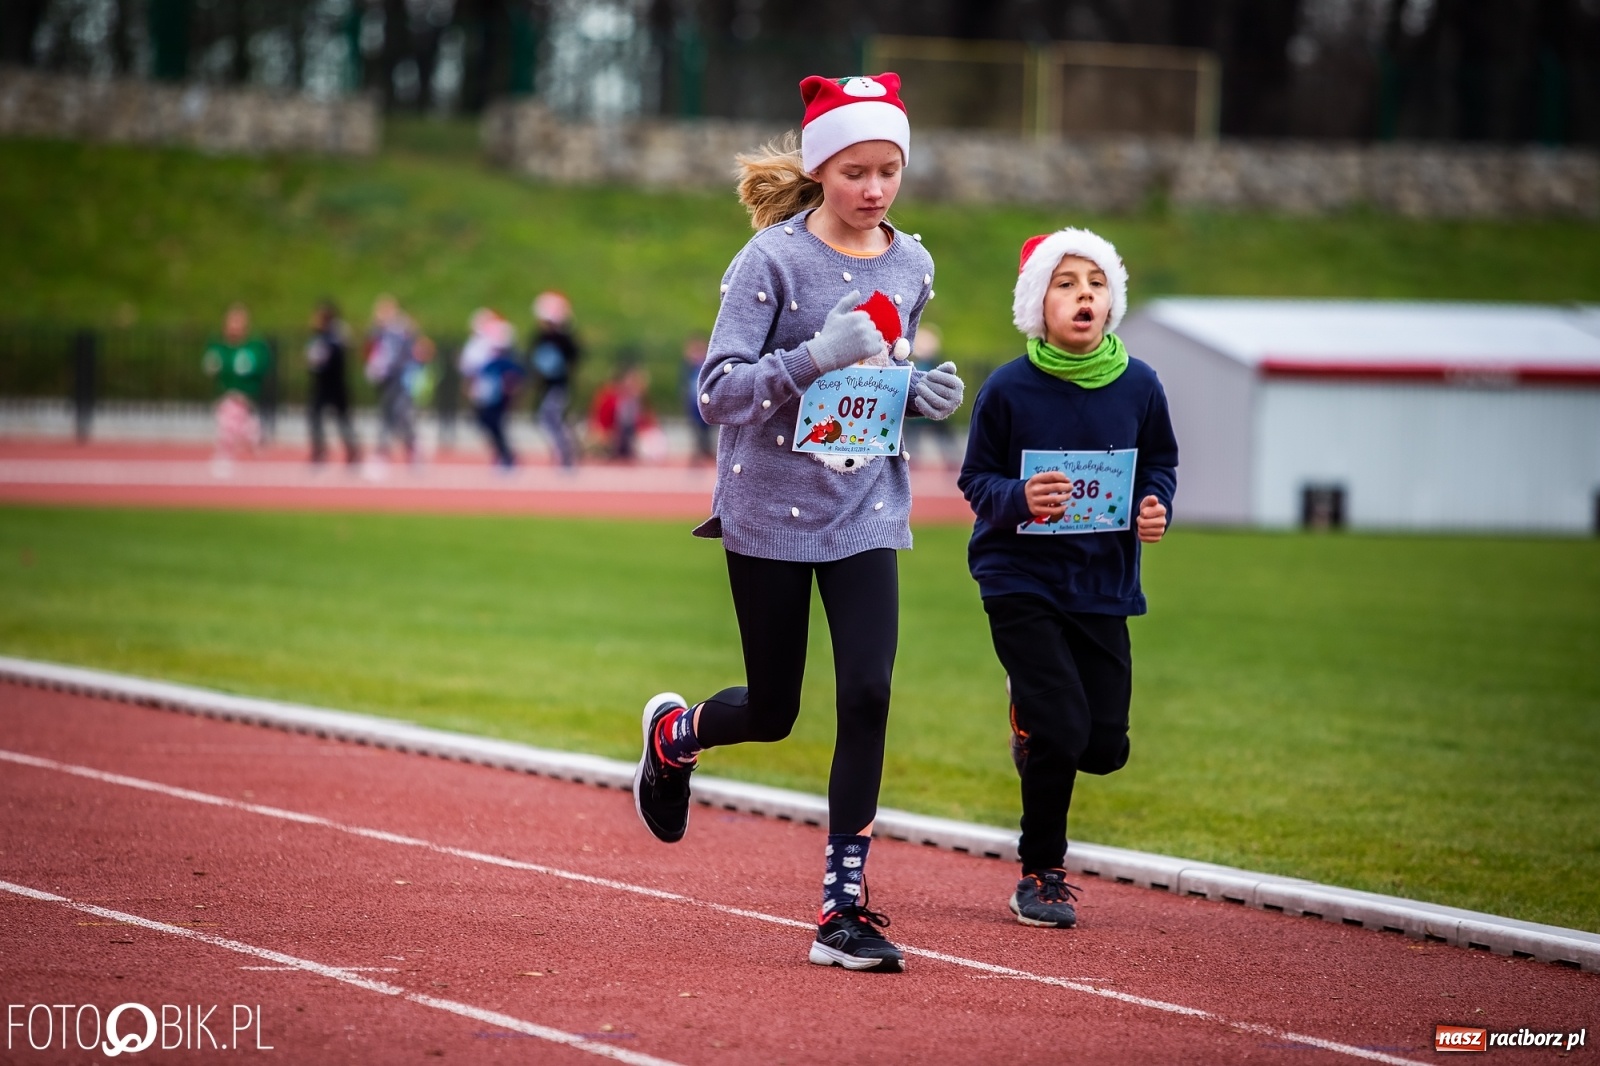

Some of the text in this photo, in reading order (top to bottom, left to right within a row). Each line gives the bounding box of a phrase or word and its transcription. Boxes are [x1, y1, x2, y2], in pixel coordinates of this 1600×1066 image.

[816, 379, 842, 391] Bieg
[838, 396, 878, 420] 087
[1072, 479, 1100, 500] 36
